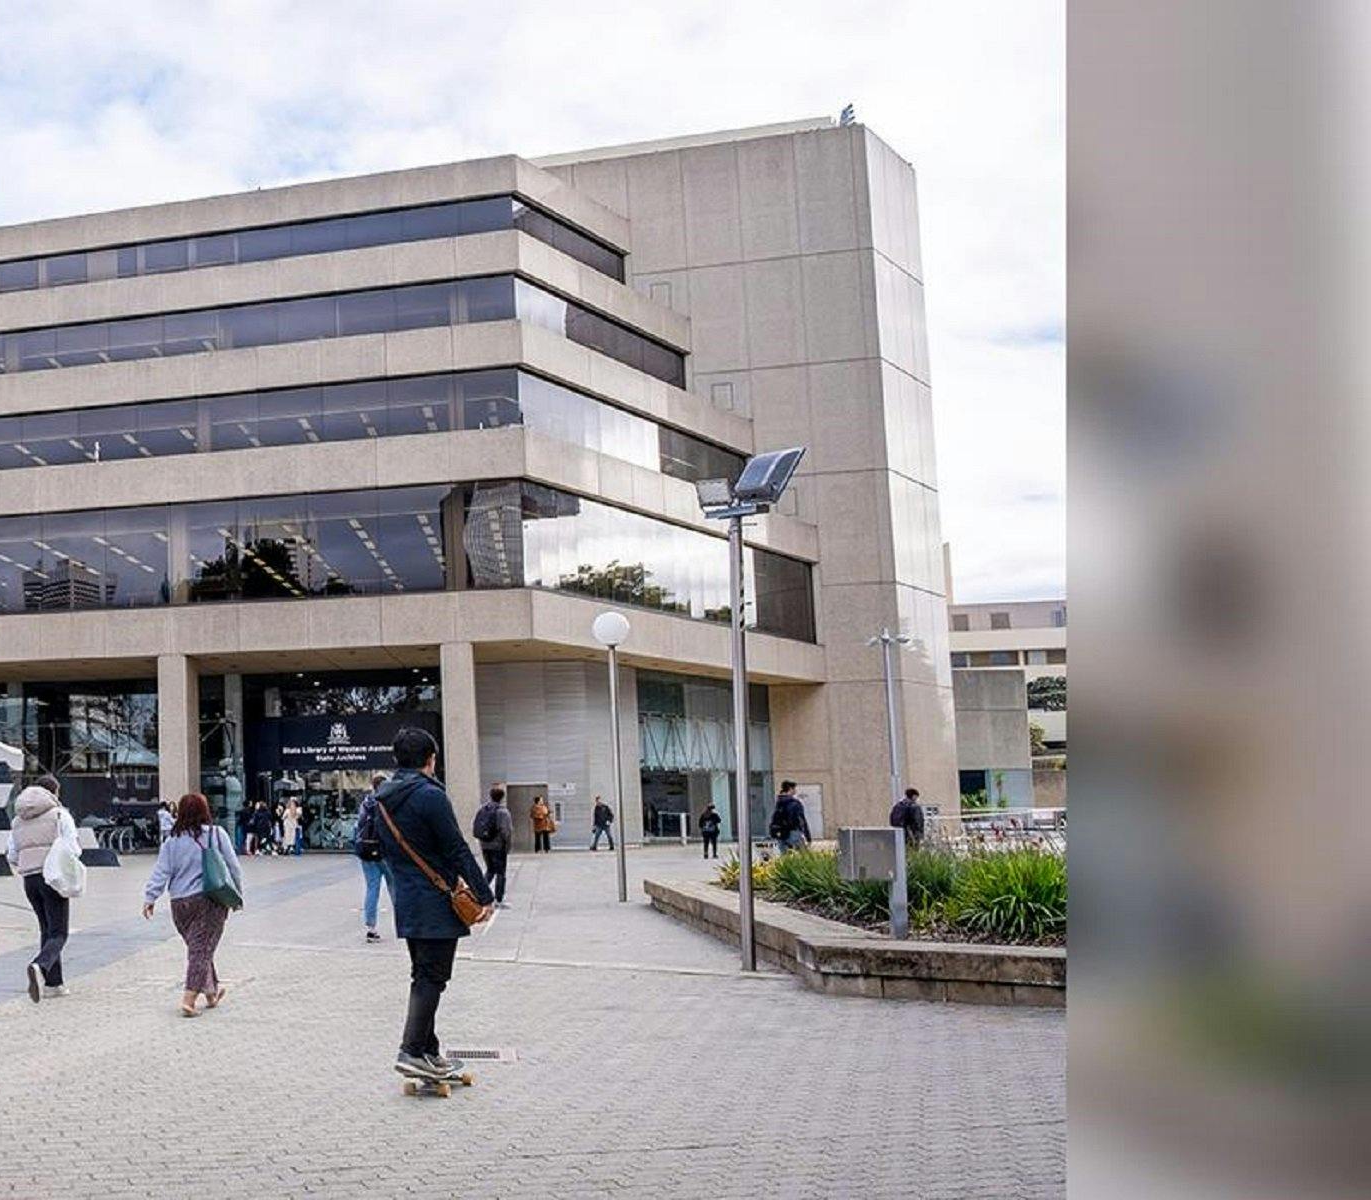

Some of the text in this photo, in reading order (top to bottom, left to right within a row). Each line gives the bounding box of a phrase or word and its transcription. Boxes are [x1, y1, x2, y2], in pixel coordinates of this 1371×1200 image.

[282, 747, 301, 755] State
[302, 747, 328, 755] Library
[329, 746, 337, 754] of
[338, 746, 367, 754] Western
